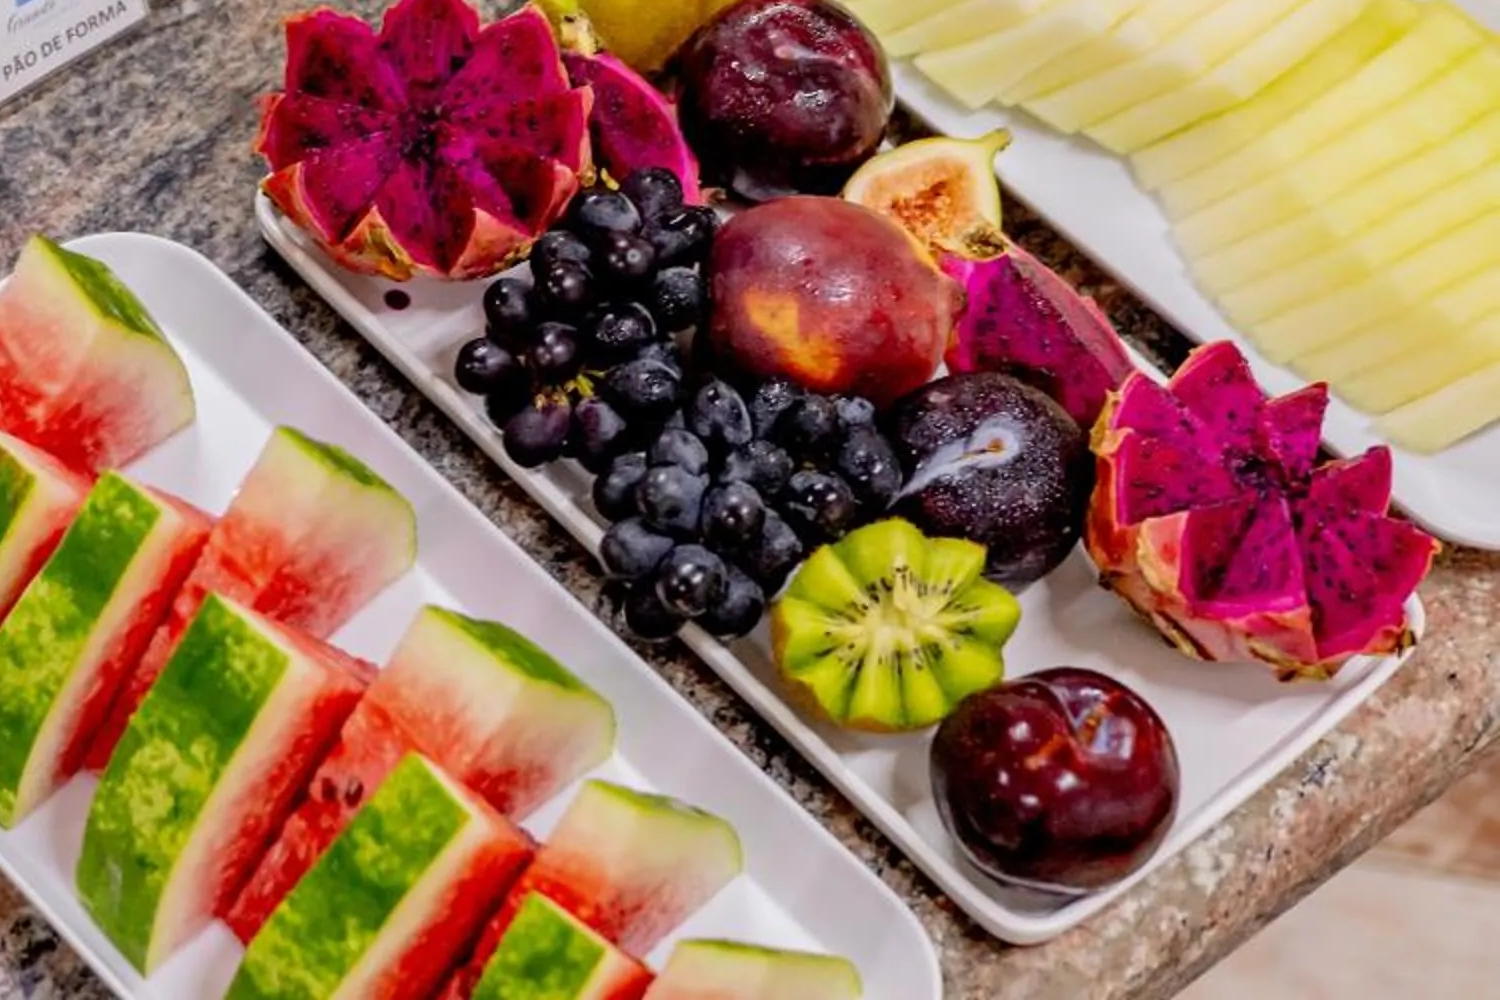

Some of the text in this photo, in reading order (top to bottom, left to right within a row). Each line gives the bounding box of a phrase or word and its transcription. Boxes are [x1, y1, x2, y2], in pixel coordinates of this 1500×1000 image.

[3, 50, 38, 81] PÃO
[40, 35, 63, 58] DE
[65, 0, 127, 44] FORMA
